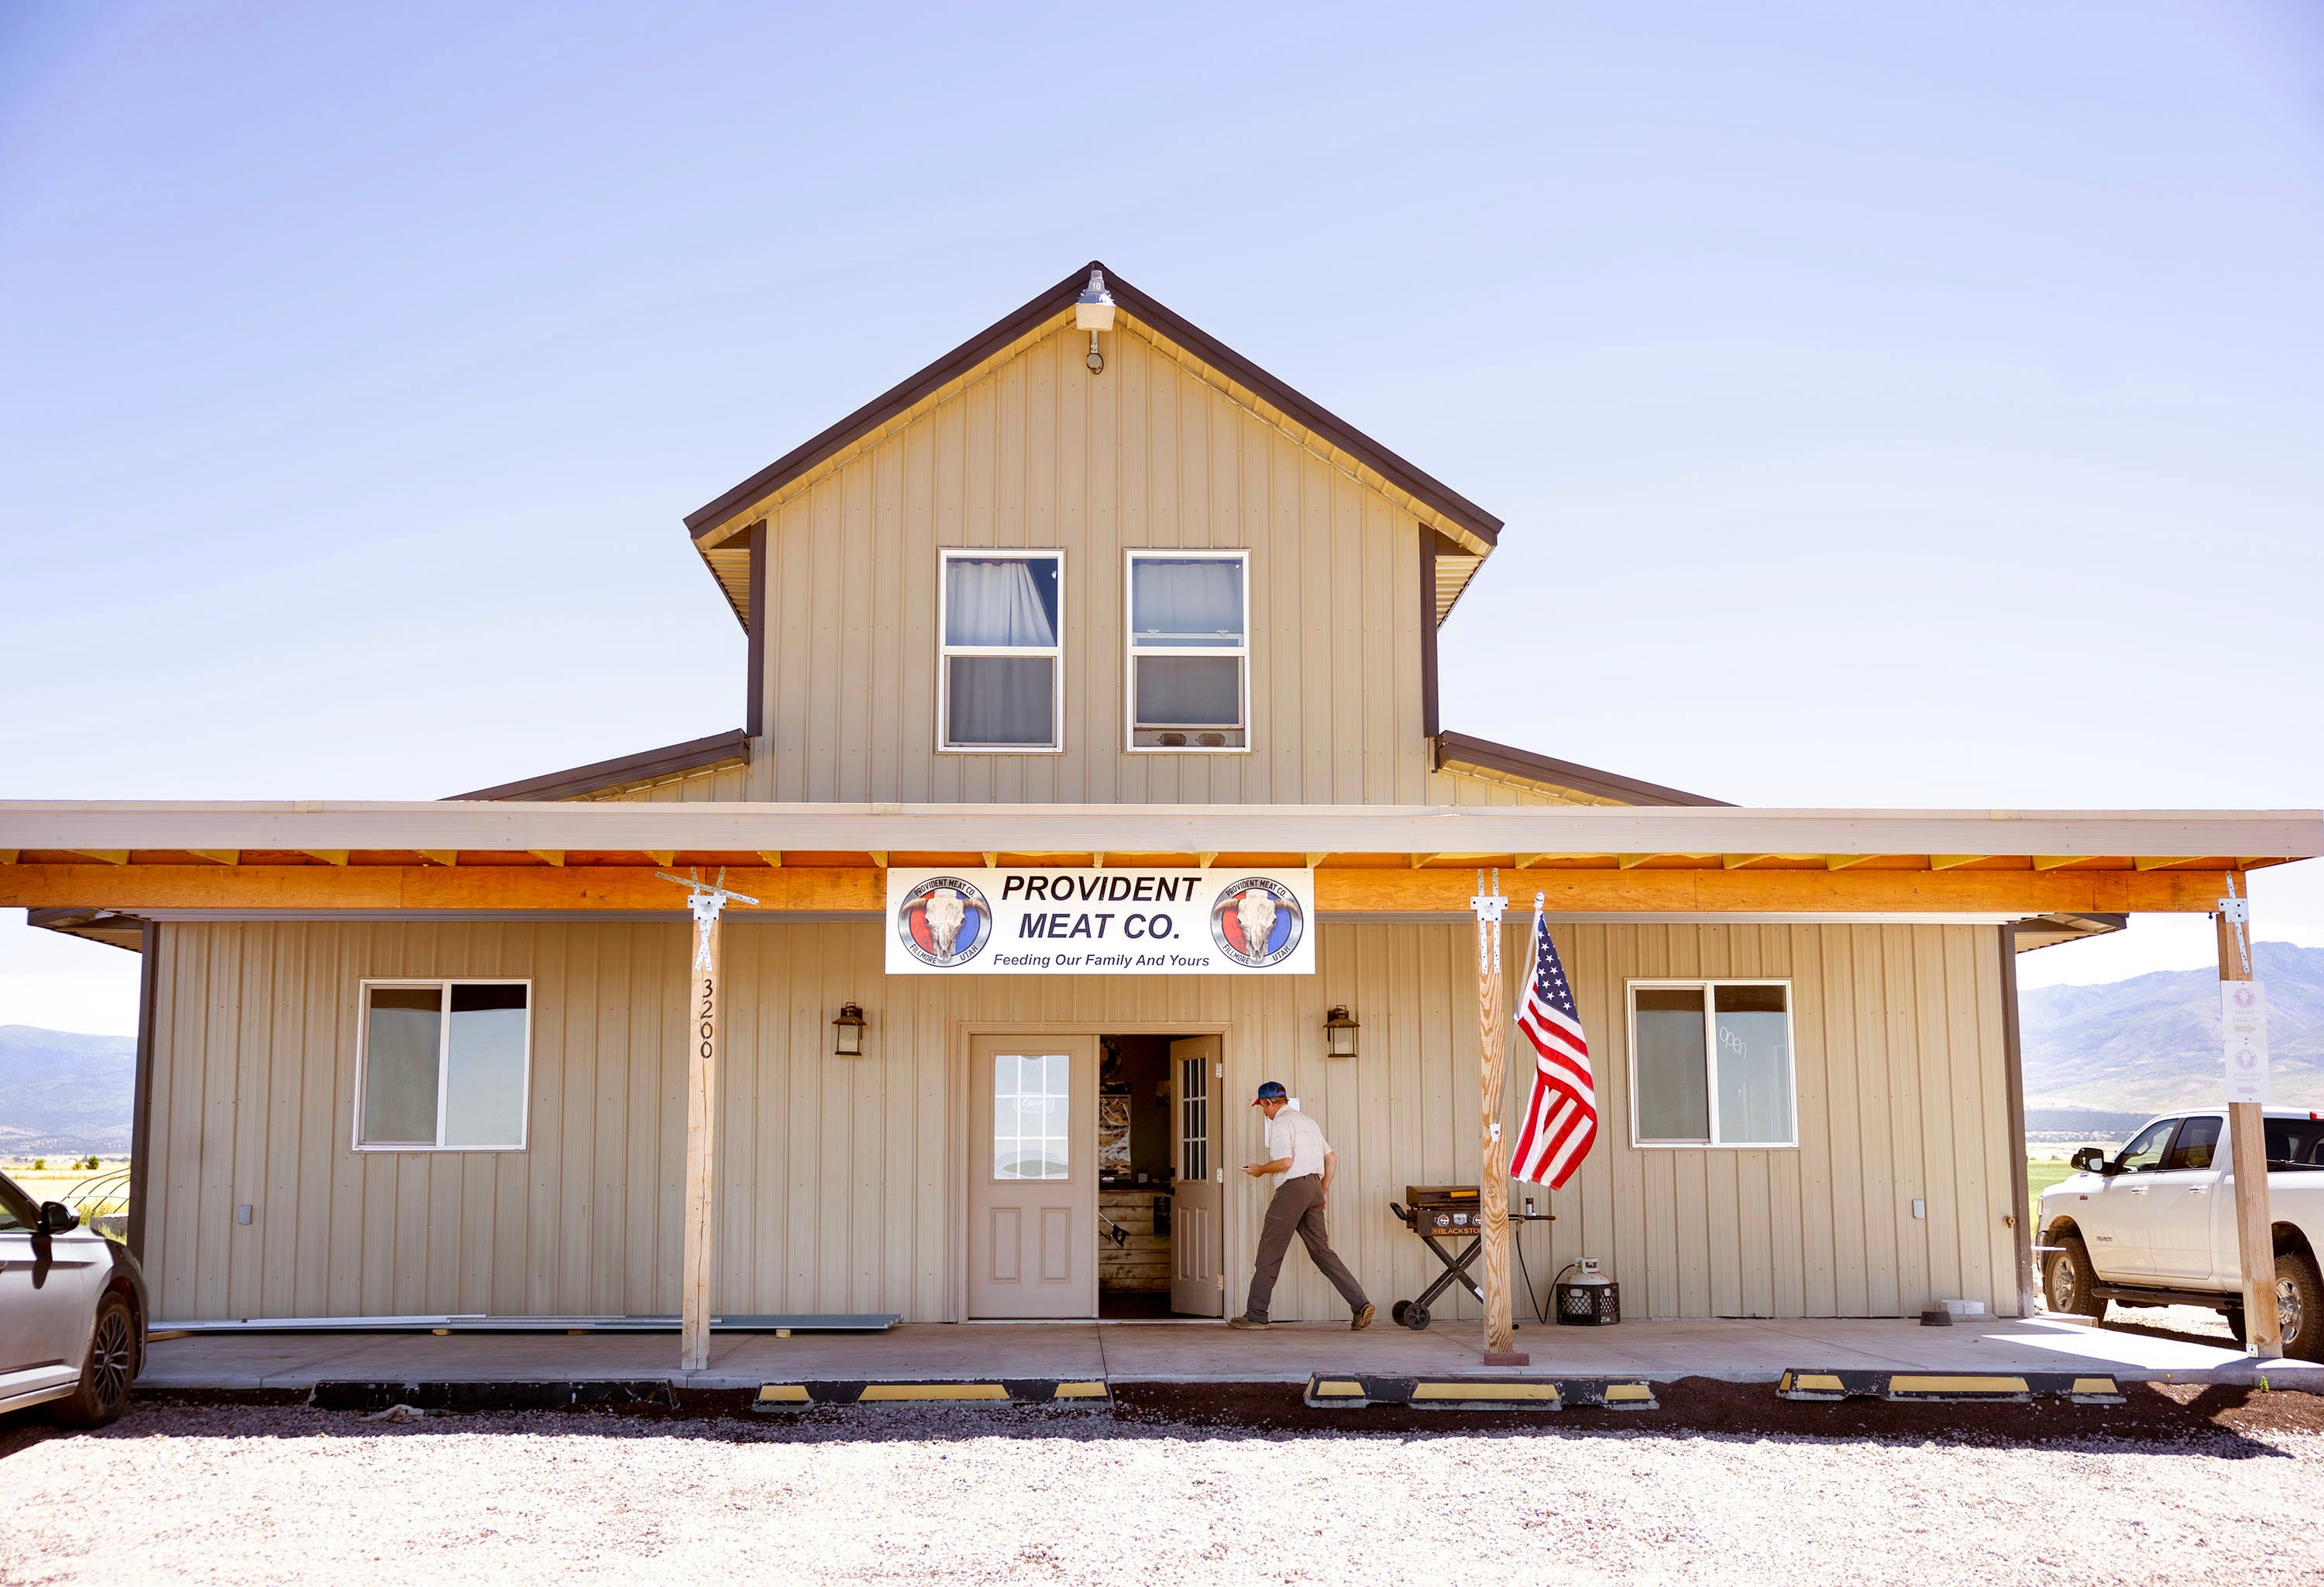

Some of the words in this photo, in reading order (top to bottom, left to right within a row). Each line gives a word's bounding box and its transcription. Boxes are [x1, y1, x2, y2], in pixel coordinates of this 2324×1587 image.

[1092, 282, 1101, 290] 10
[913, 878, 947, 897] PROVIDENT
[948, 879, 966, 890] MEAT
[965, 886, 975, 898] CO.
[1002, 875, 1202, 902] PROVIDENT
[1226, 879, 1259, 897] PROVIDENT
[1260, 880, 1277, 891] MEAT
[1277, 887, 1287, 898] CO.
[1019, 913, 1115, 939] MEAT
[1123, 913, 1180, 939] CO.
[909, 943, 937, 964] FILLMORE
[959, 945, 978, 961] UTAH
[993, 953, 1050, 968] Feeding
[1055, 953, 1082, 966] Our
[1085, 953, 1133, 968] Family
[1136, 954, 1165, 967] And
[1170, 954, 1210, 967] Yours
[1222, 943, 1250, 964] FILLMORE
[1271, 946, 1291, 961] UTAH
[700, 978, 713, 1059] 3200
